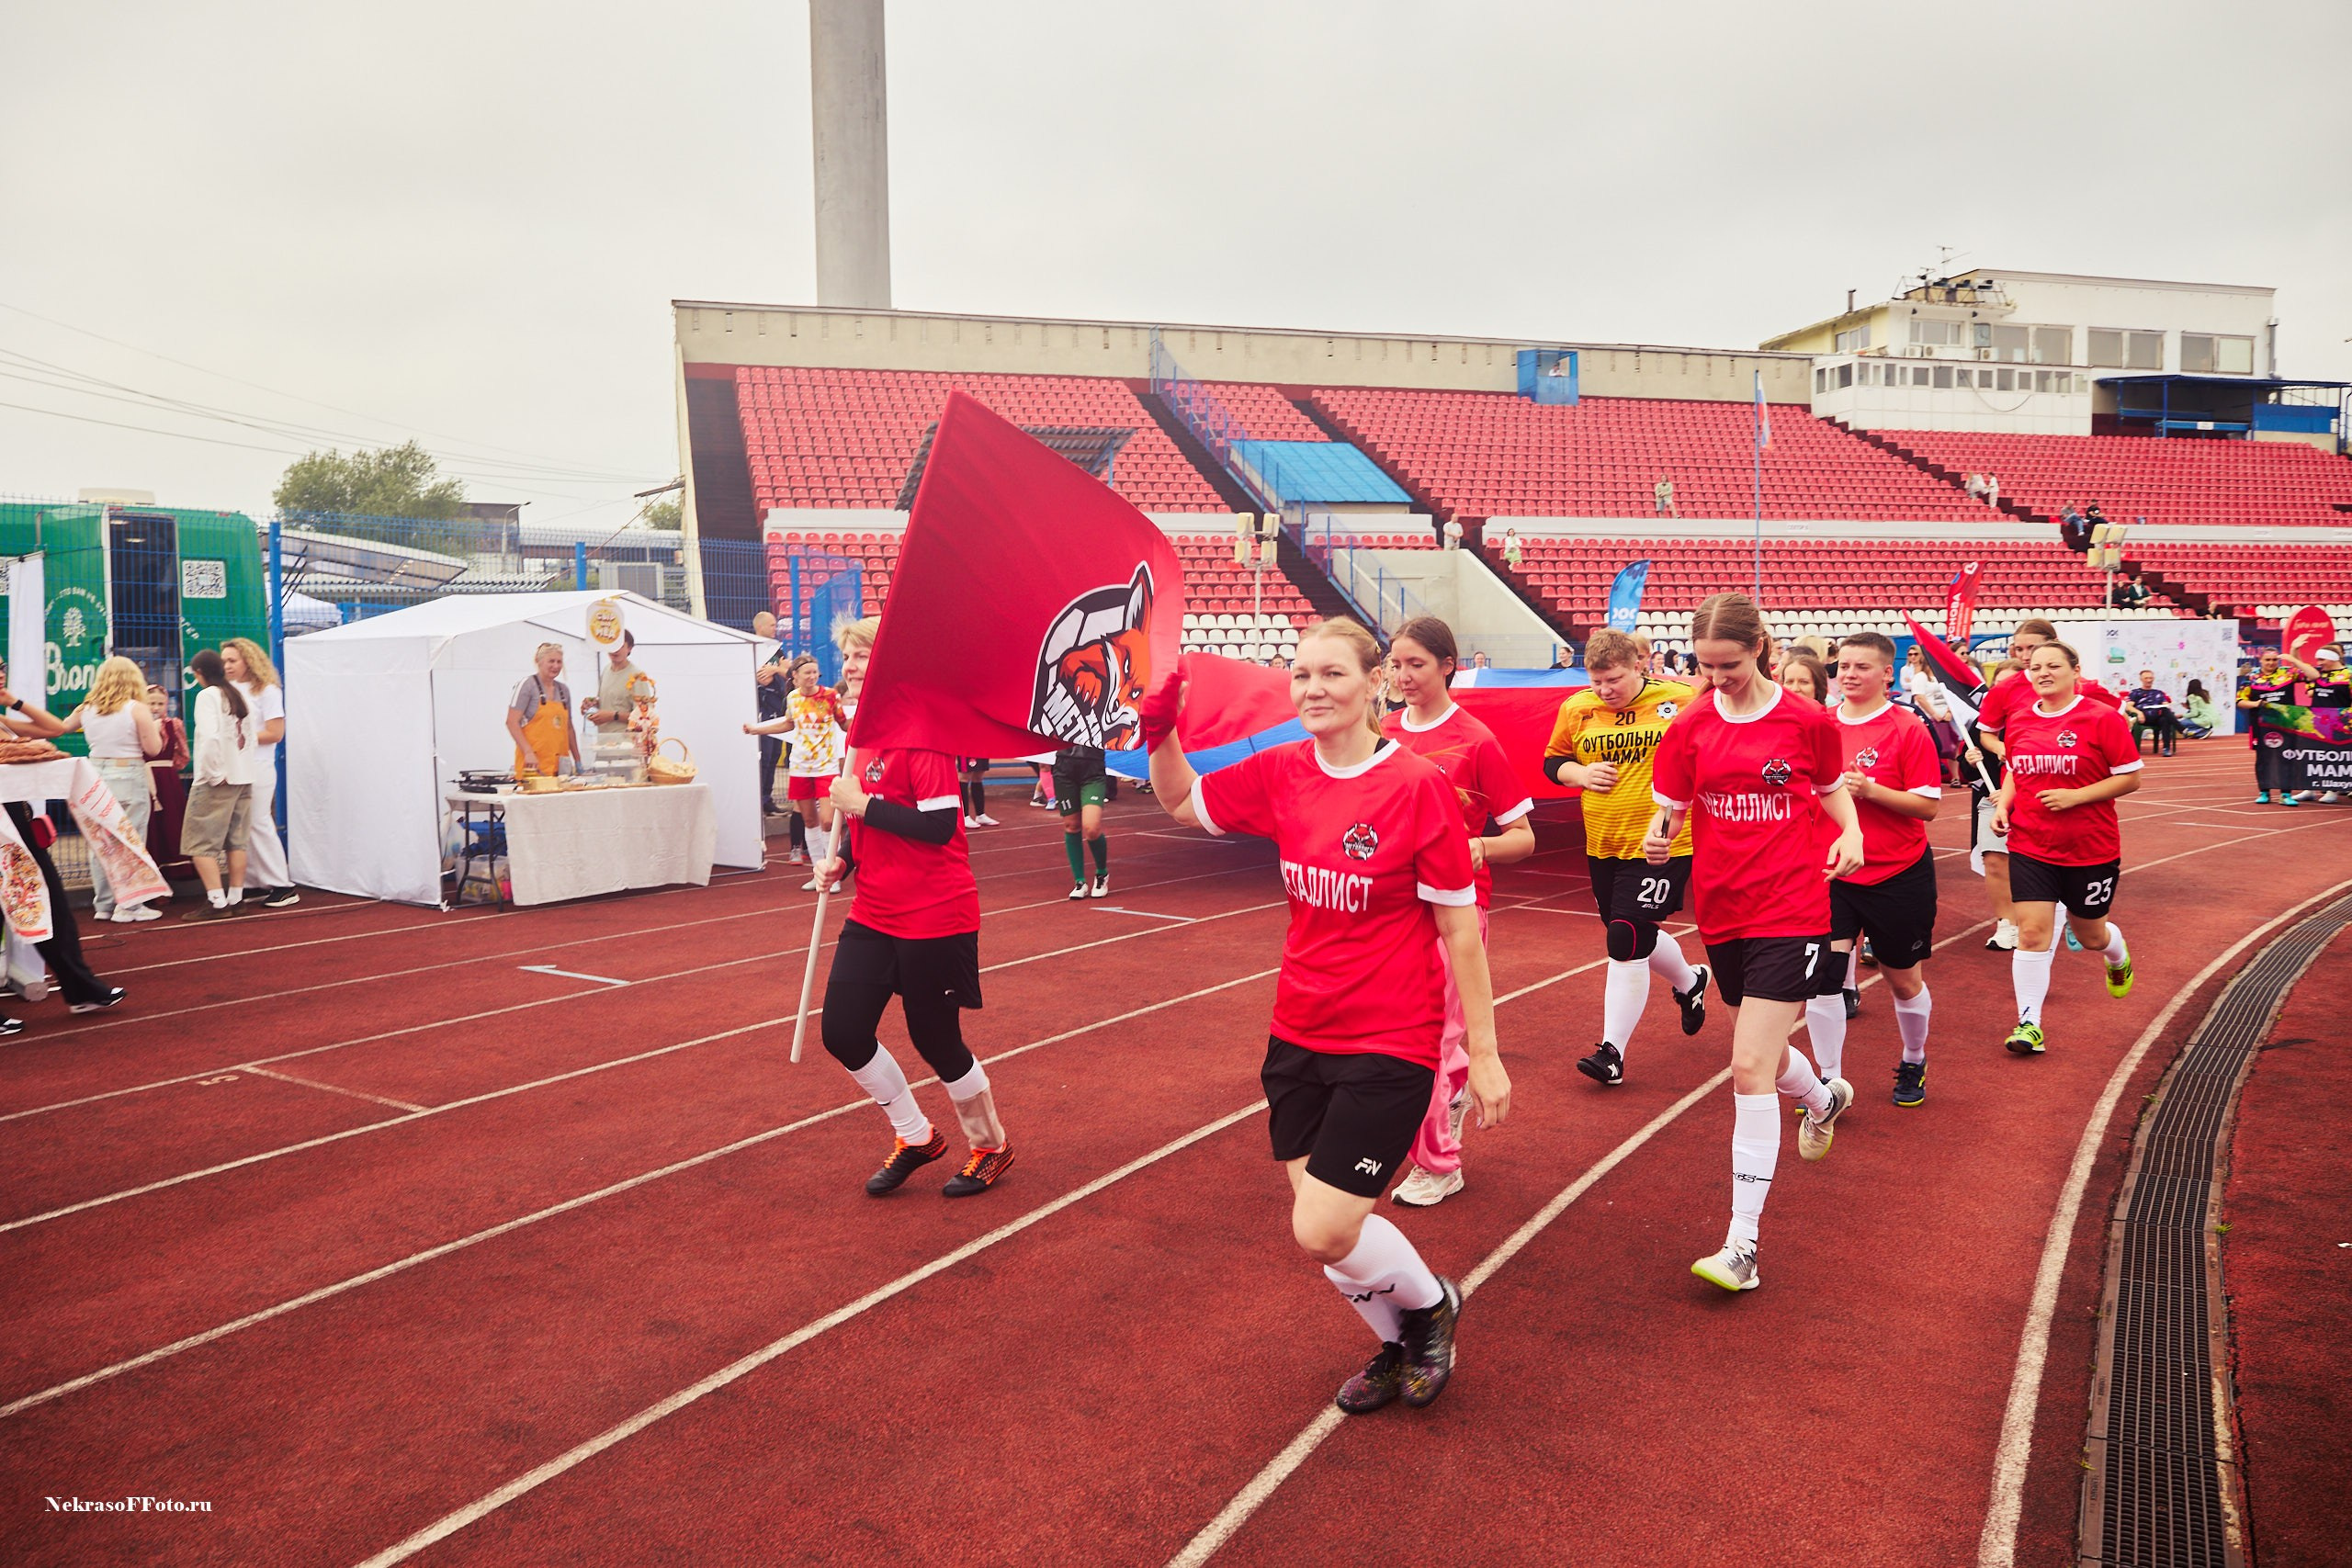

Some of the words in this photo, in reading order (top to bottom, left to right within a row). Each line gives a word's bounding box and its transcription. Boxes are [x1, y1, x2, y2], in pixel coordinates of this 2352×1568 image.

[44, 641, 104, 695] Bron
[1615, 711, 1636, 726] 20
[1583, 730, 1663, 753] ФУТБОЛЬНА
[1600, 747, 1647, 764] МАМА!
[1061, 798, 1072, 811] 11
[1697, 791, 1793, 822] МЕТАЛЛИСТ
[1636, 877, 1670, 904] 20
[2084, 877, 2113, 906] 23
[1804, 942, 1821, 980] 7
